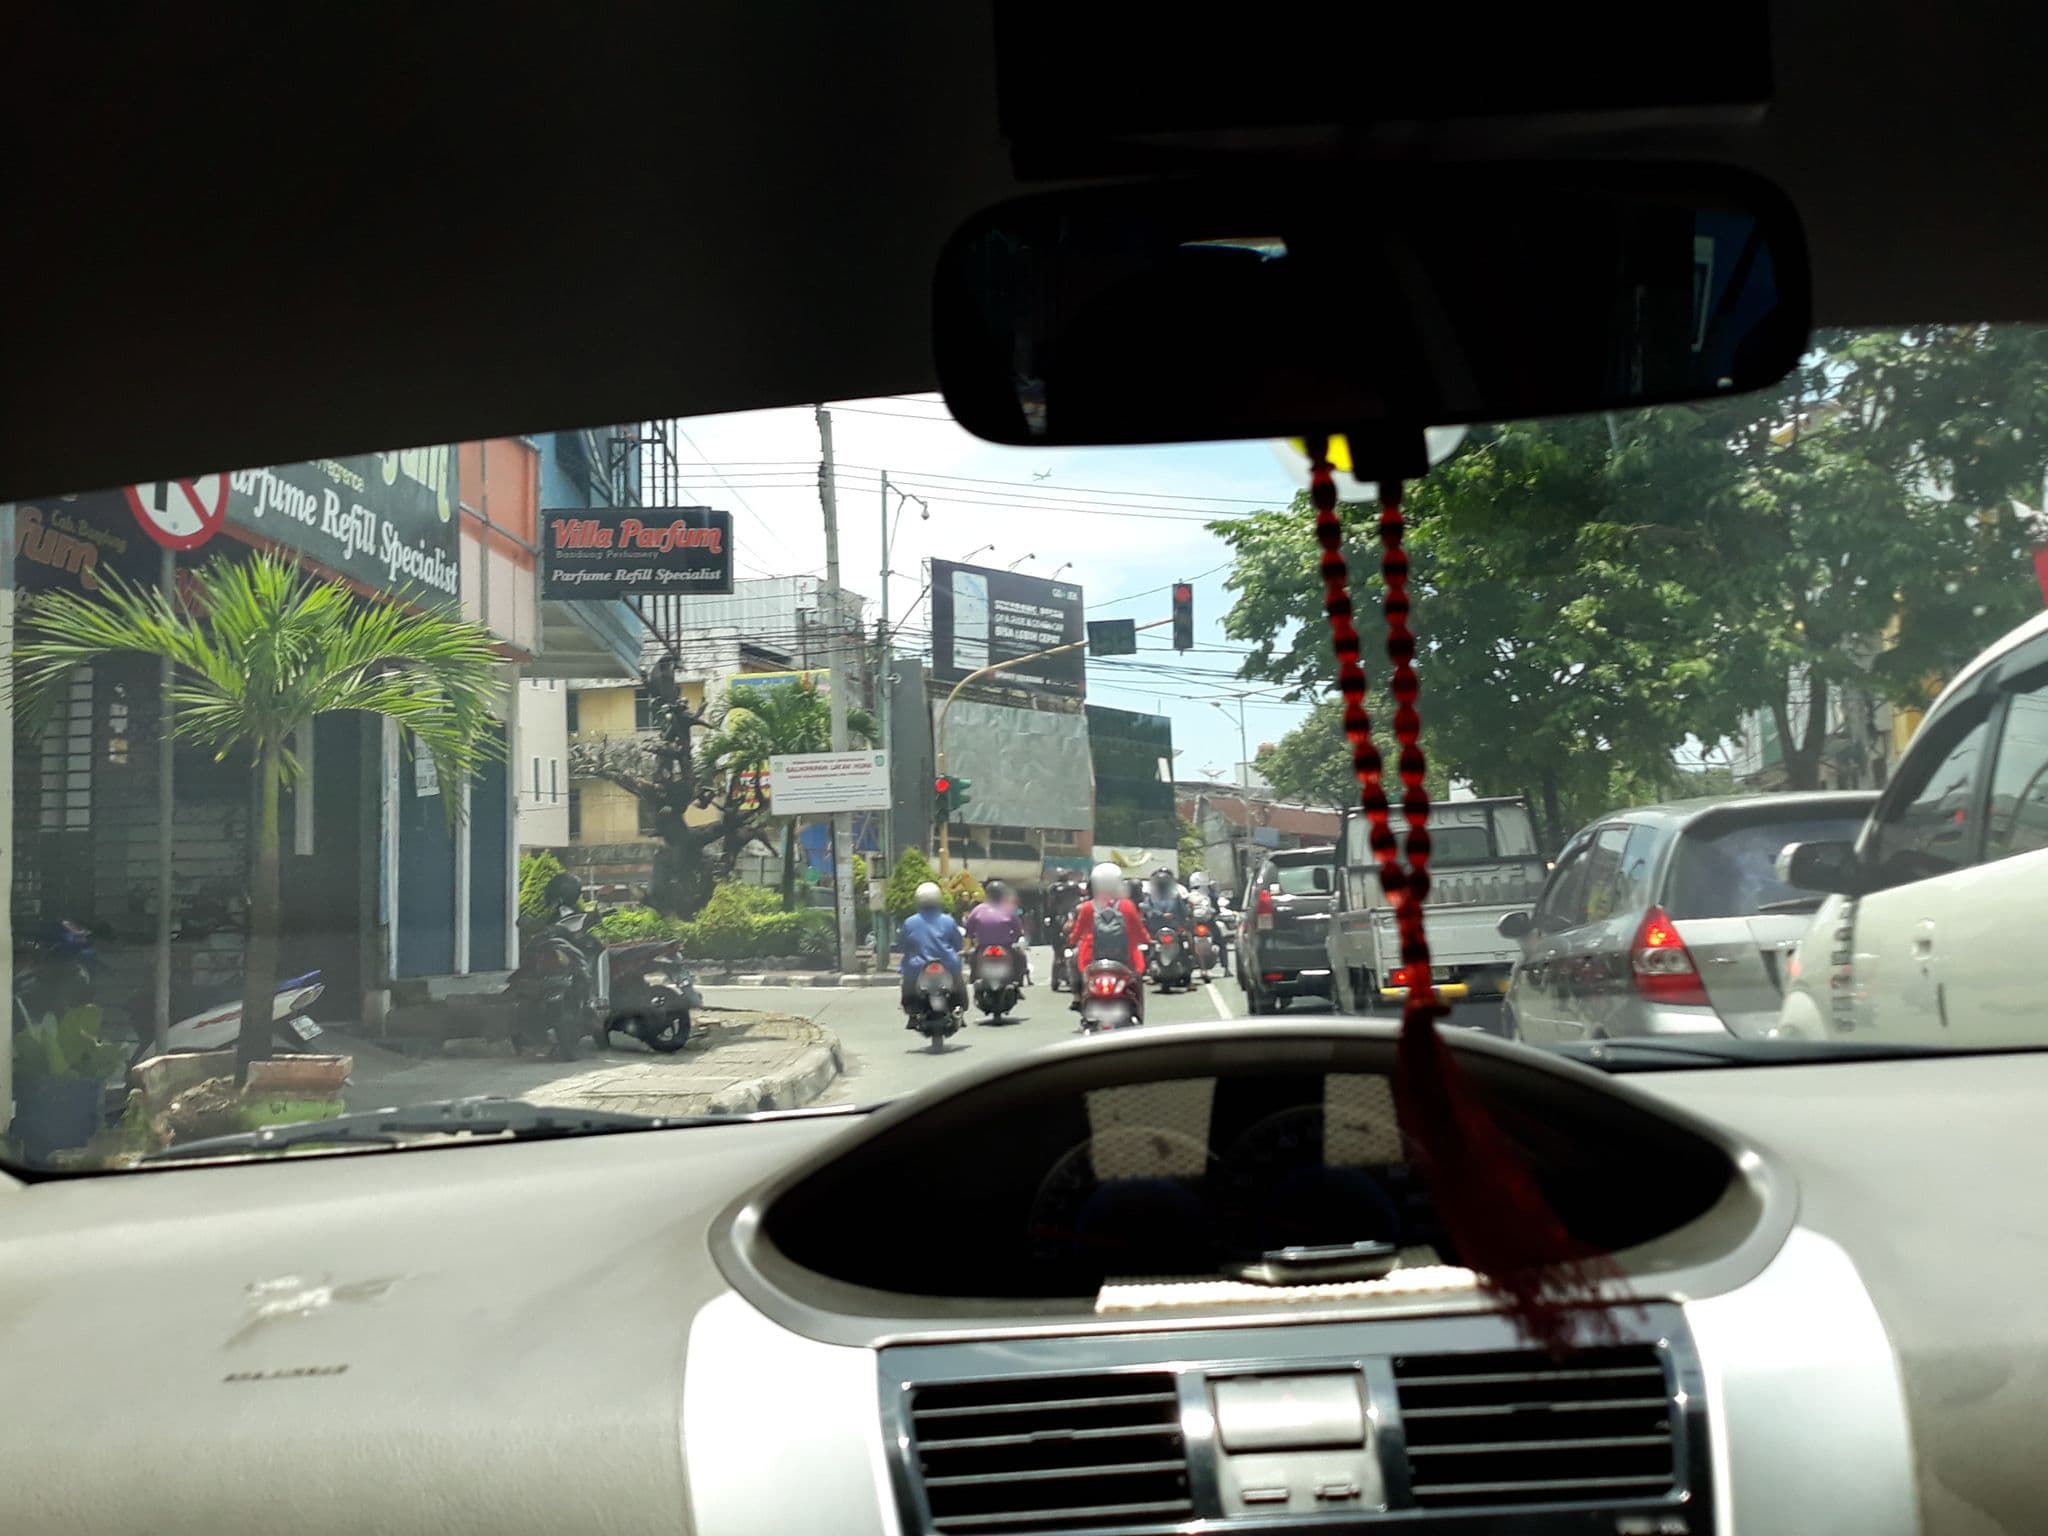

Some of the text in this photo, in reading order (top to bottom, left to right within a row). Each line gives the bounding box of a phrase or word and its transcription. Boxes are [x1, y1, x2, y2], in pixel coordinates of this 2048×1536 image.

[320, 488, 377, 560] Refill
[380, 521, 458, 595] Specialist
[552, 518, 722, 554] Villa Parfum
[552, 568, 721, 585] Parfume Refill Specialist
